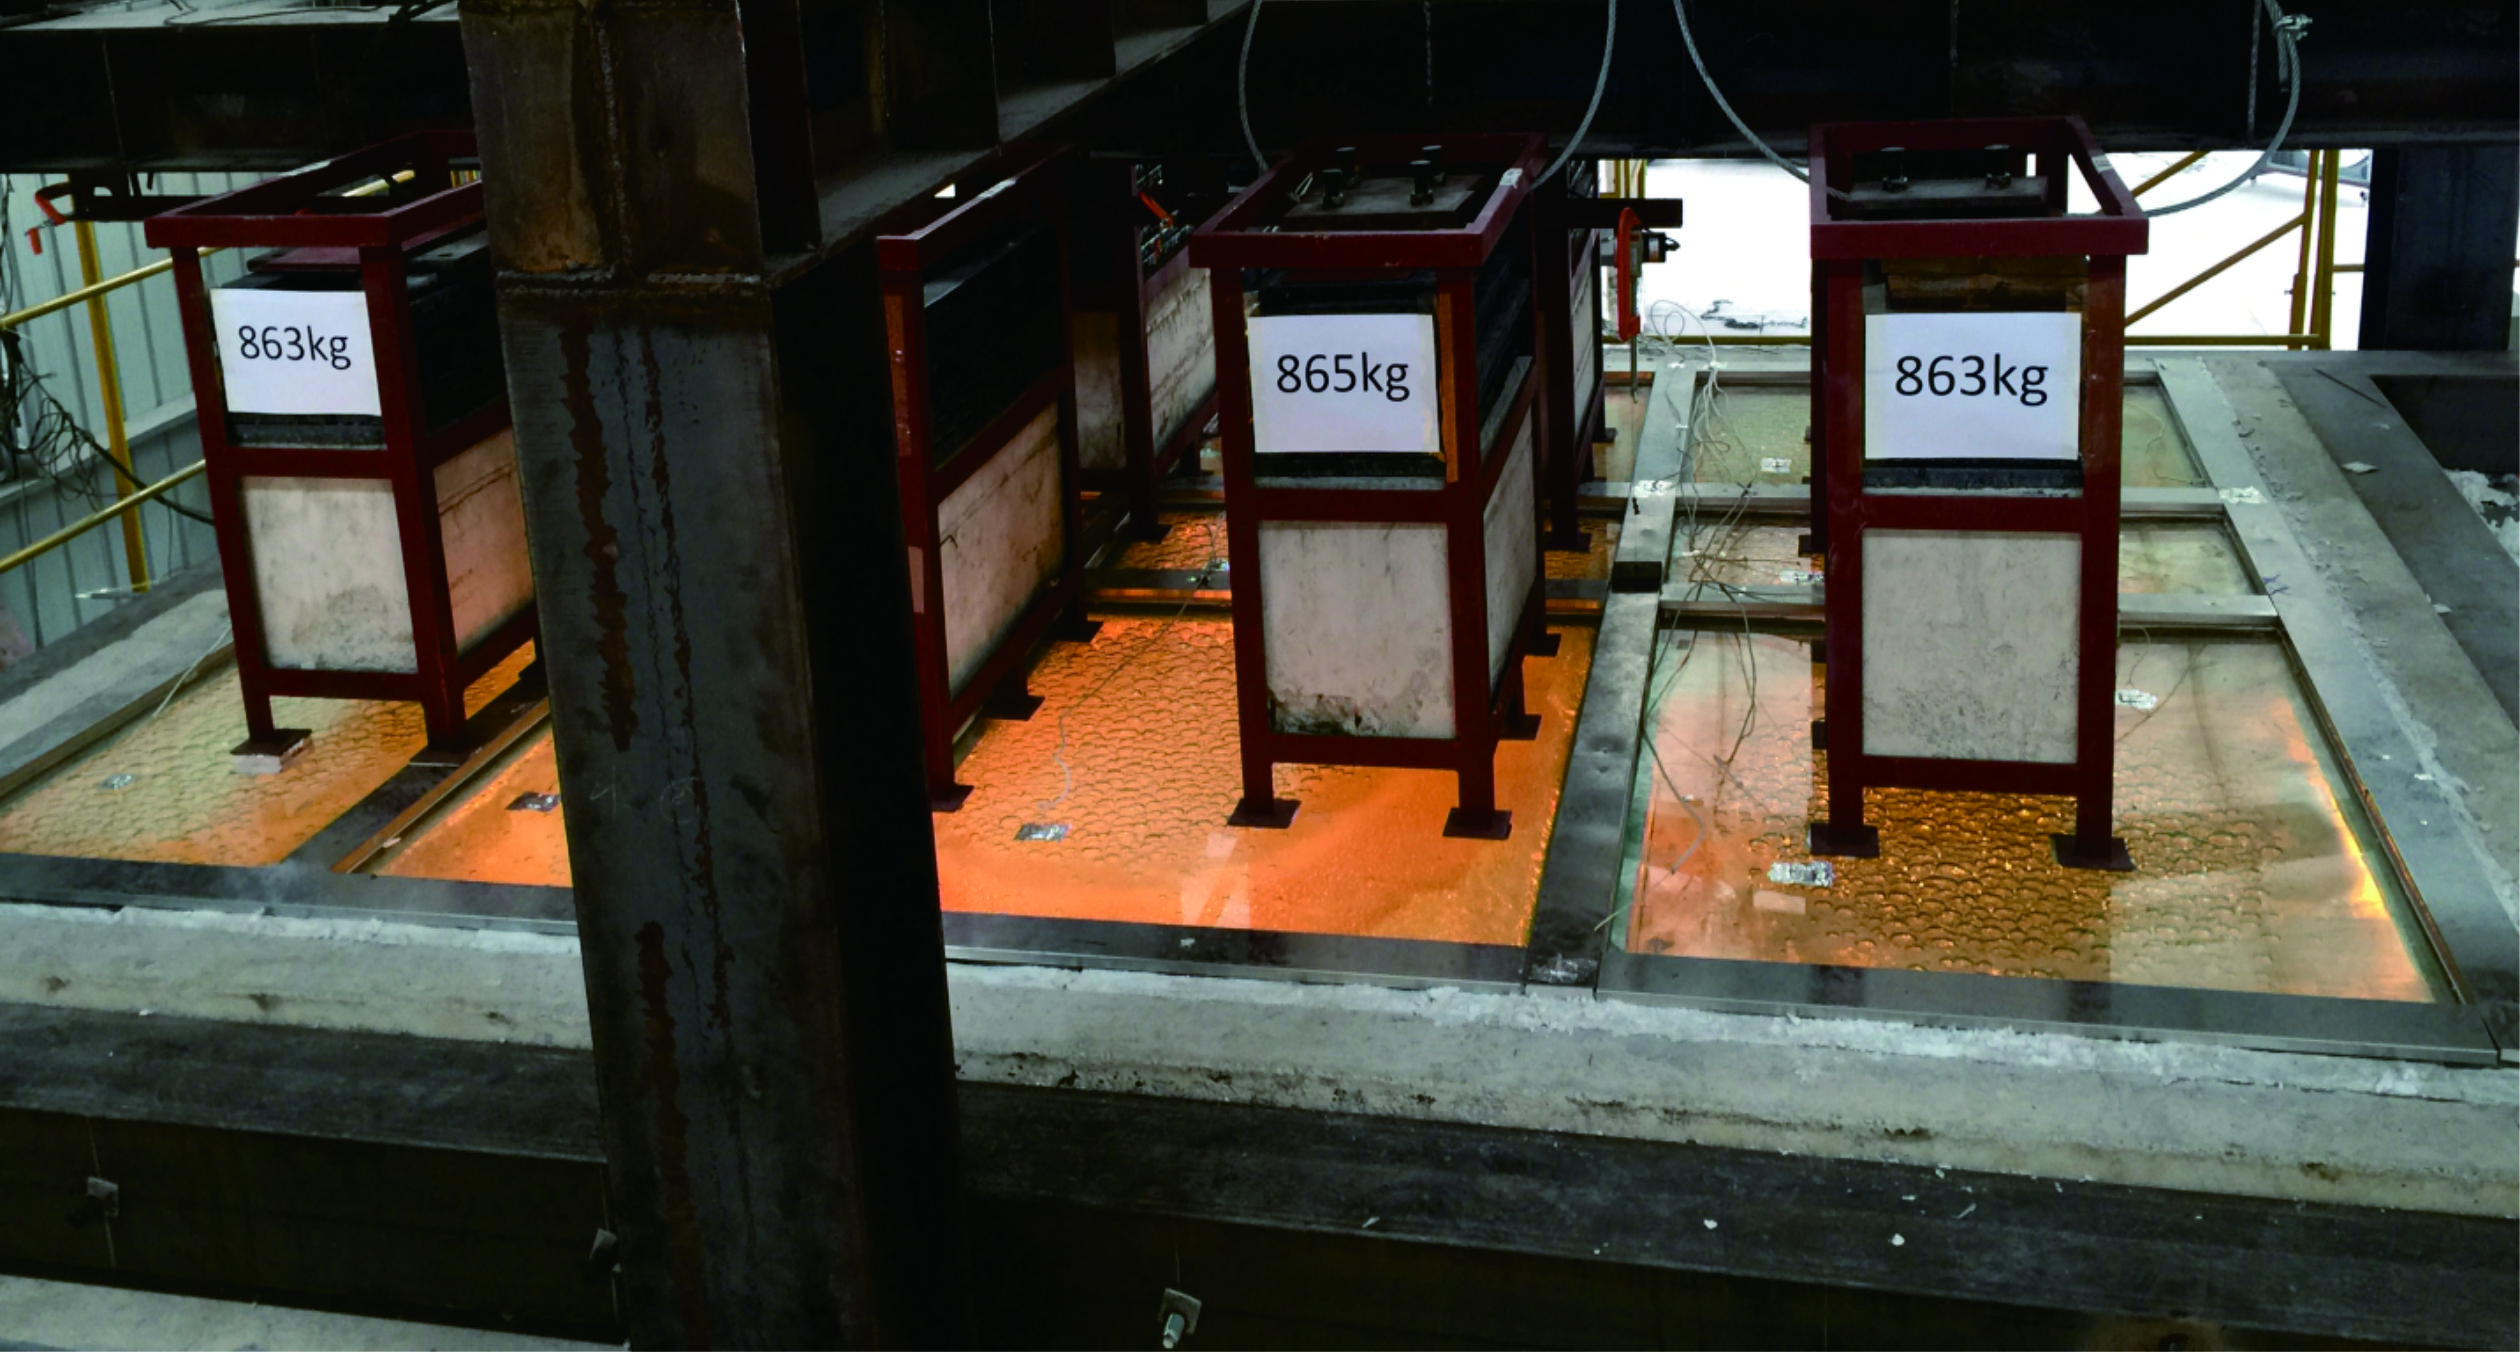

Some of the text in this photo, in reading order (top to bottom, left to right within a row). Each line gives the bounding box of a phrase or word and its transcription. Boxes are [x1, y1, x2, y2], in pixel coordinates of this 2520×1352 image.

[239, 325, 351, 370] 863kg
[1277, 351, 1411, 402] 865kg
[1896, 353, 2049, 406] 863kg
